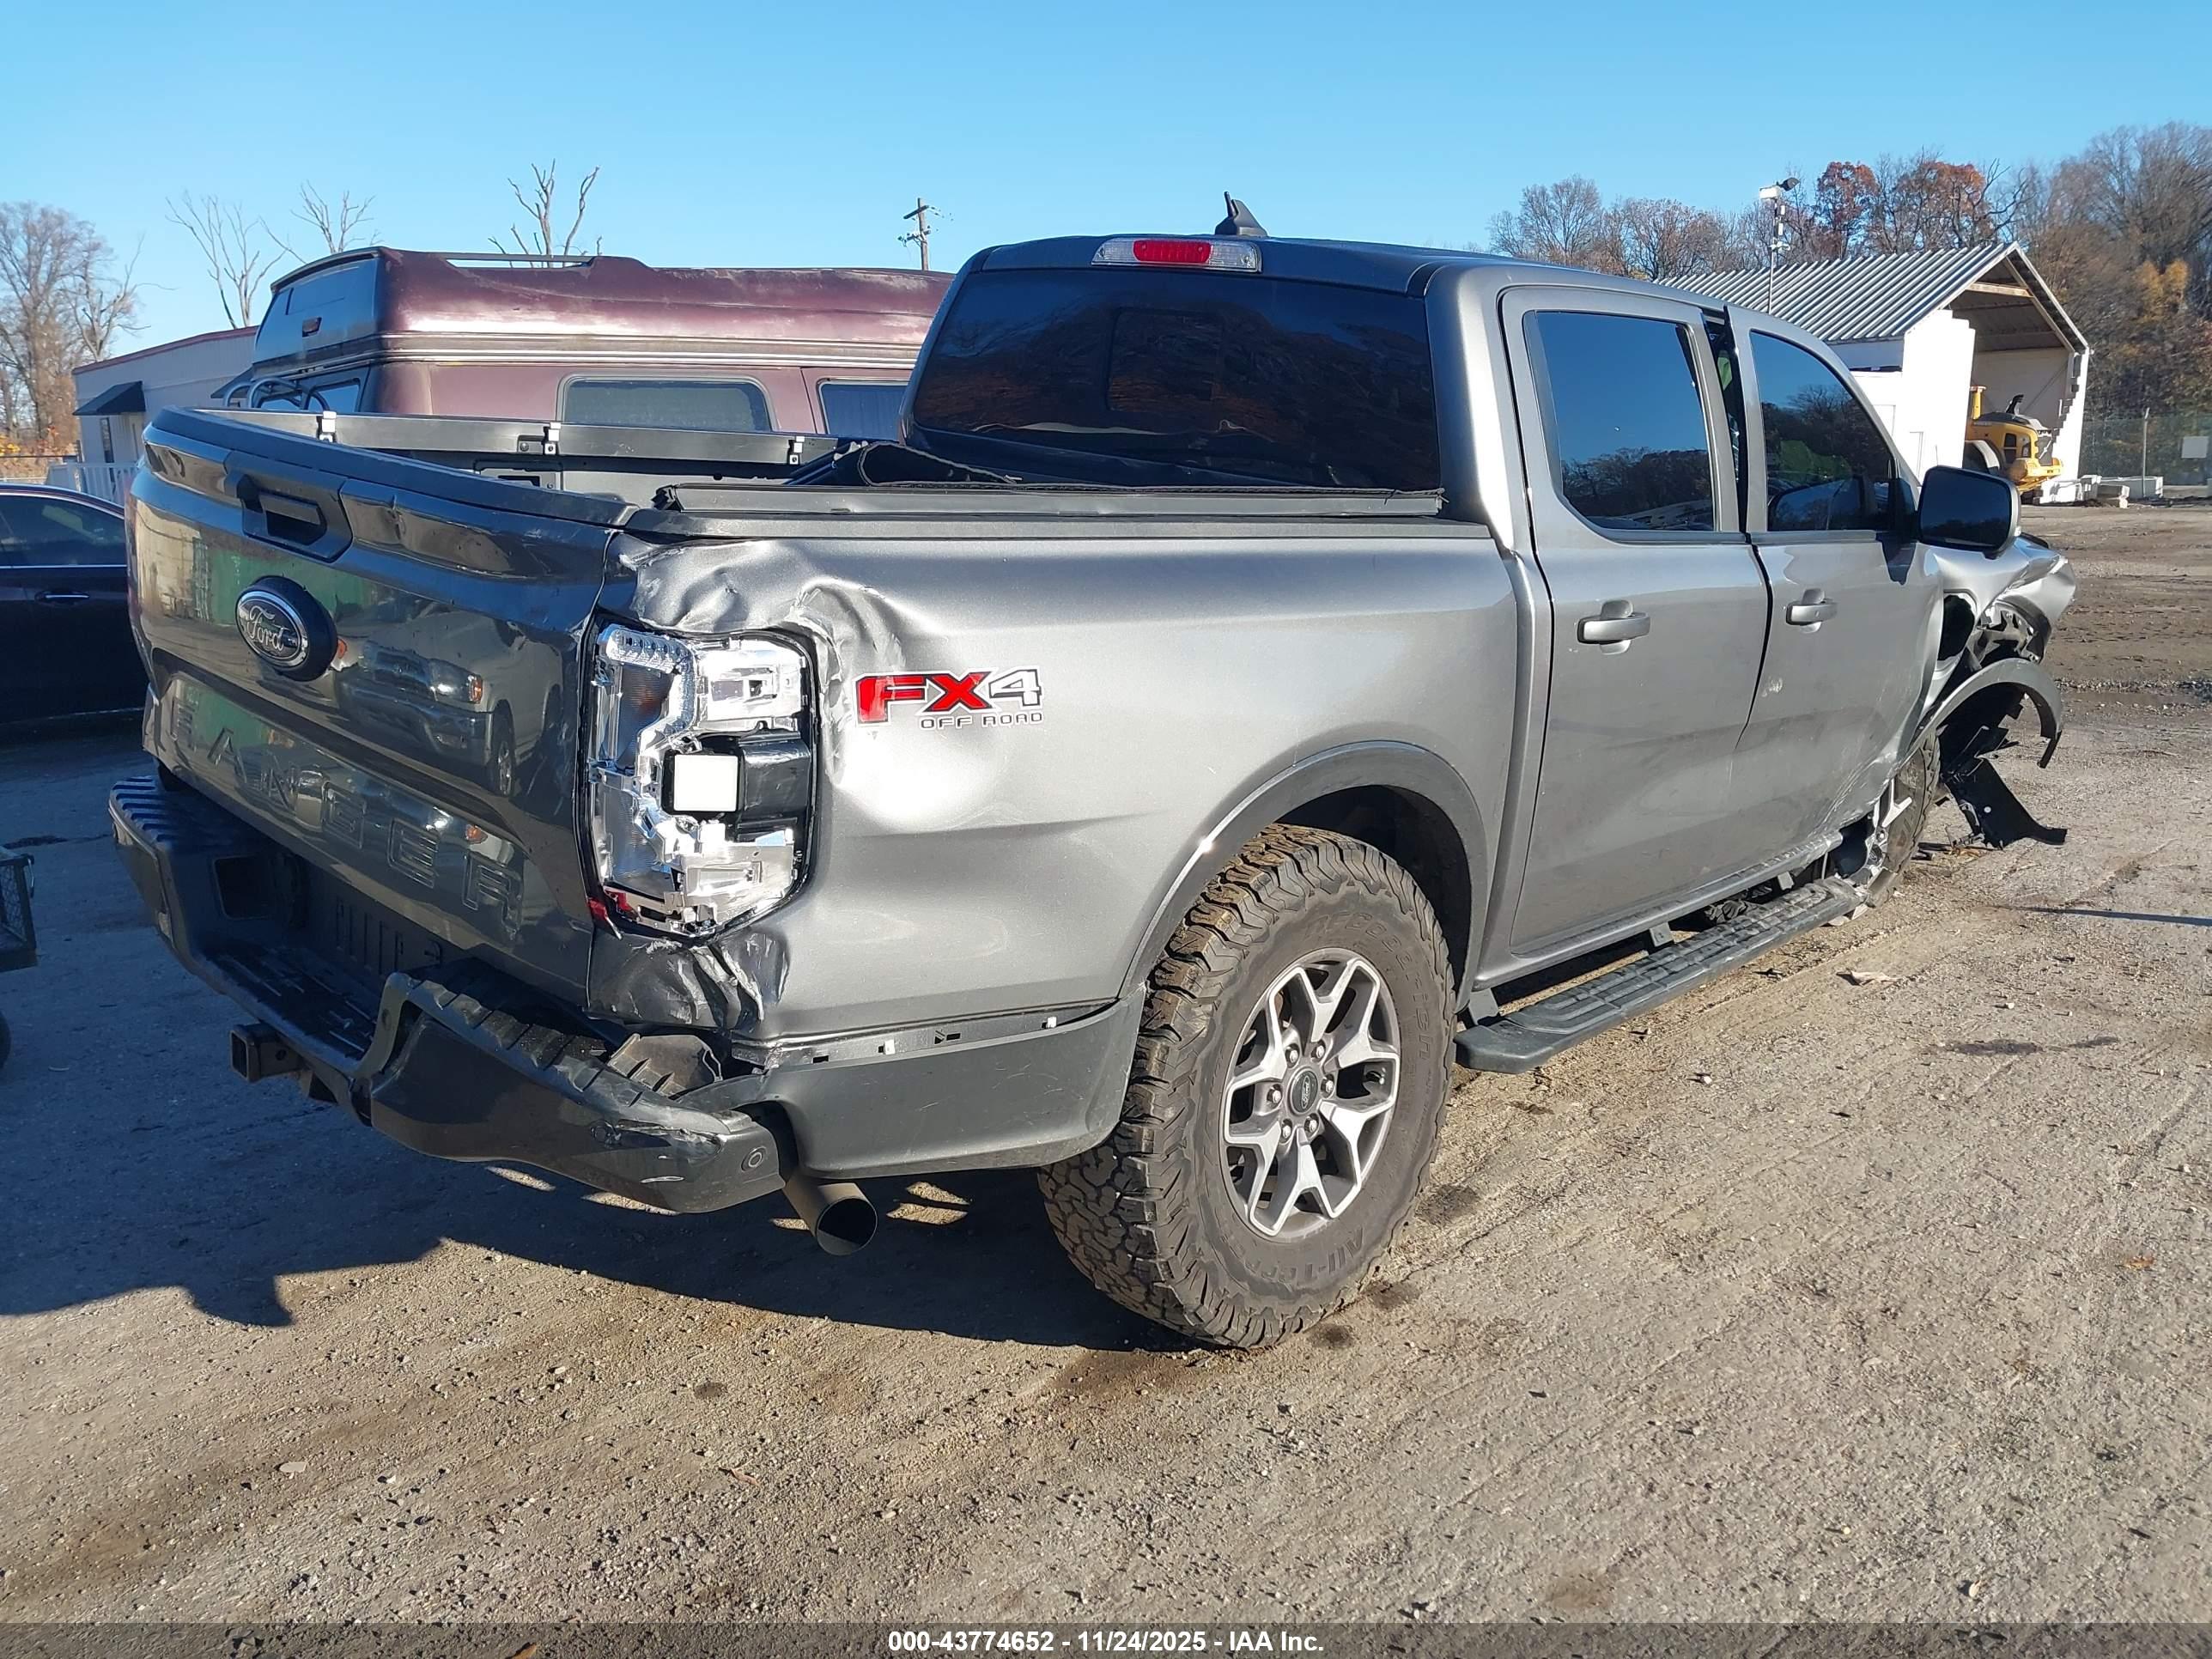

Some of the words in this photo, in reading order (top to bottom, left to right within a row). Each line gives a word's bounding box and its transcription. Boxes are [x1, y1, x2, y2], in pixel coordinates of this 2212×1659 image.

[247, 605, 284, 651] Ford
[854, 667, 1043, 726] FX4
[921, 714, 972, 729] OFF
[981, 712, 1043, 726] ROAD
[171, 694, 525, 941] RANGER
